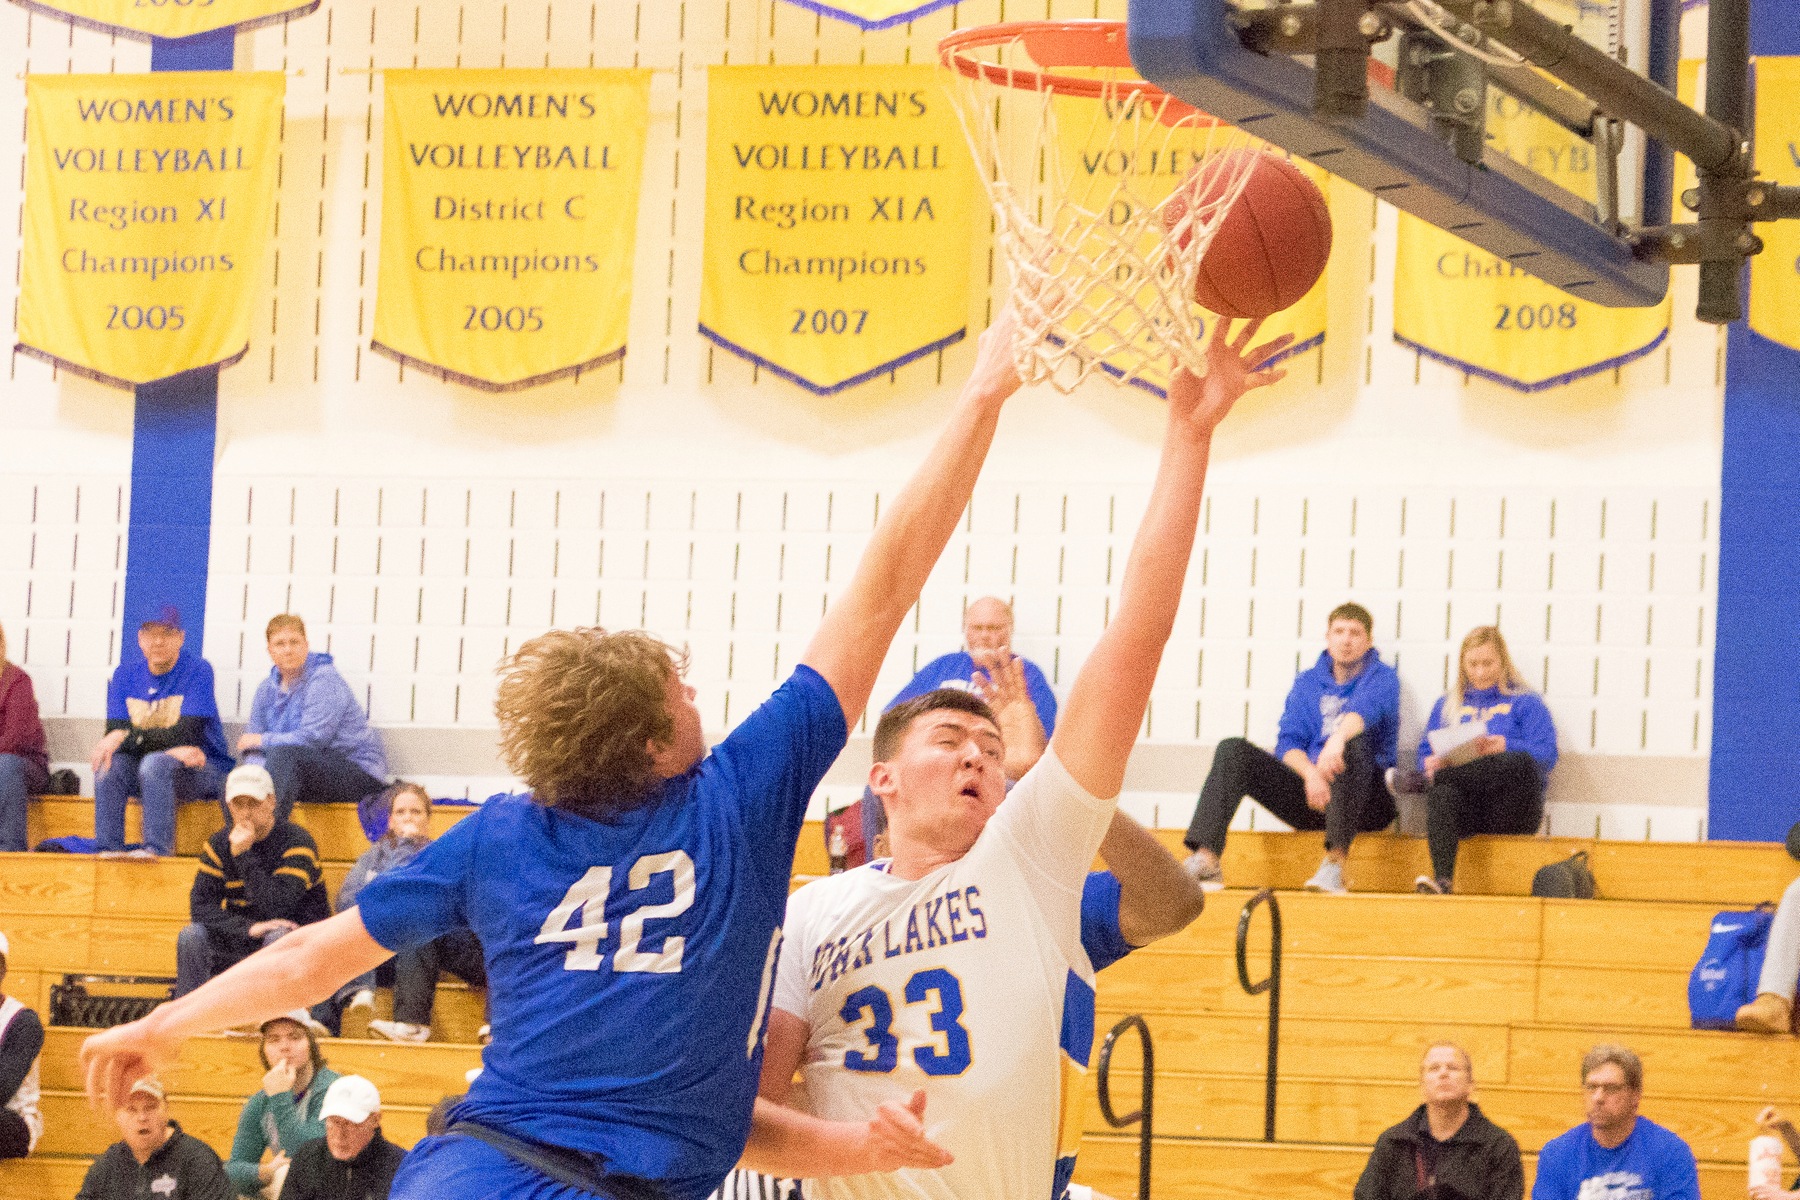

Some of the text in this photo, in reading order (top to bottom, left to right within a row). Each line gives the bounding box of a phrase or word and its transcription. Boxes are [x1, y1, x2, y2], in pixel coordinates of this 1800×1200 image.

[77, 96, 235, 123] WOMEN'S
[433, 93, 596, 119] WOMEN'S
[759, 91, 927, 118] WOMEN'S
[54, 146, 251, 173] VOLLEYBALL
[410, 143, 618, 170] VOLLEYBALL
[733, 143, 946, 170] VOLLEYBALL
[69, 197, 227, 230] Region XI
[434, 194, 586, 221] District C
[735, 194, 850, 229] Region
[61, 248, 235, 282] Champions
[415, 245, 599, 280] Champions
[738, 247, 927, 283] Champions
[106, 304, 185, 332] 2005
[463, 304, 544, 332] 2005
[791, 308, 870, 335] 2007
[1495, 302, 1577, 331] 2008
[533, 849, 697, 974] 42
[883, 885, 988, 960] LAKES
[839, 966, 973, 1077] 33
